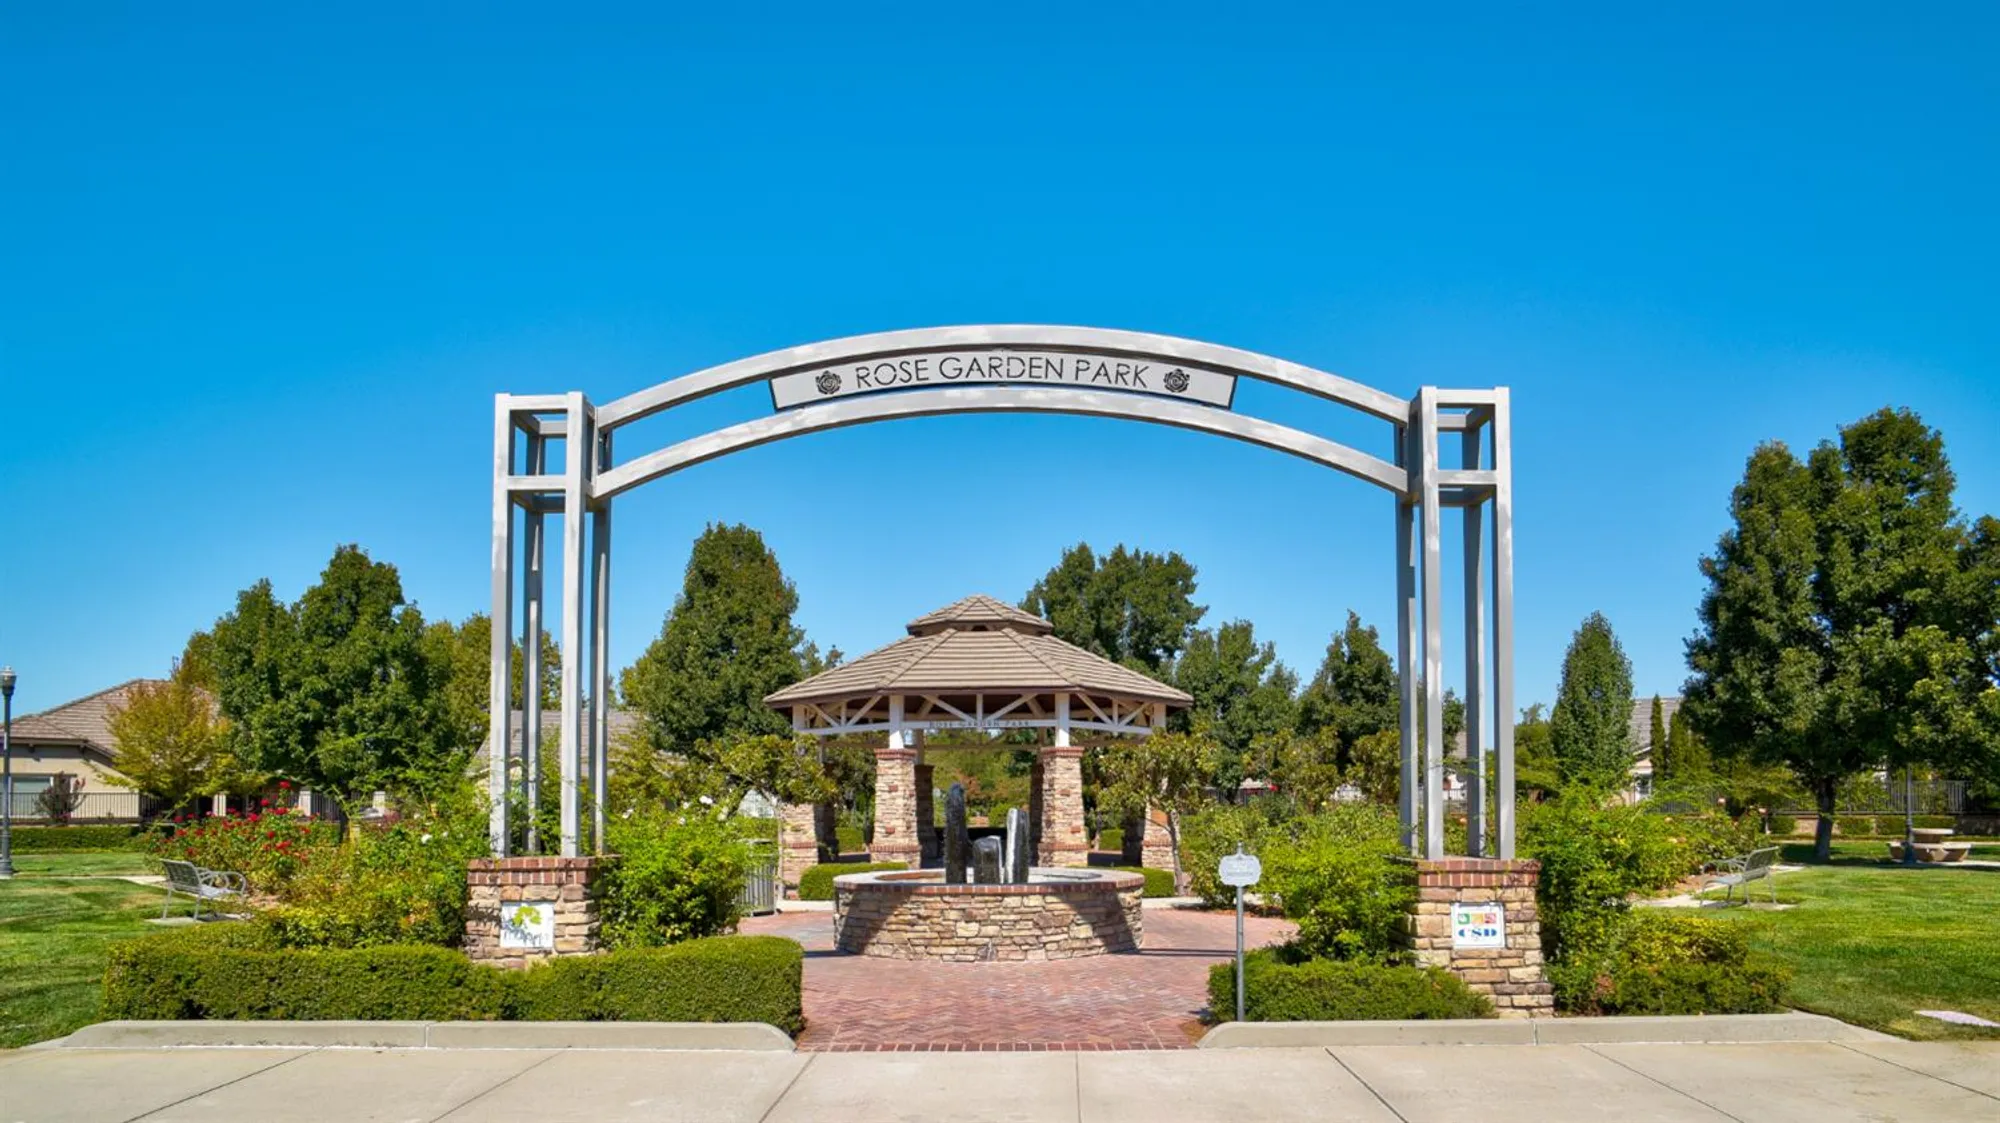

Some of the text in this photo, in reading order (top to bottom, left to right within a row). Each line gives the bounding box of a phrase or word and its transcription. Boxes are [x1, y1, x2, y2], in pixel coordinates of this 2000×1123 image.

[855, 357, 1150, 389] ROSE GARDEN PARK
[1458, 928, 1497, 938] CSD
